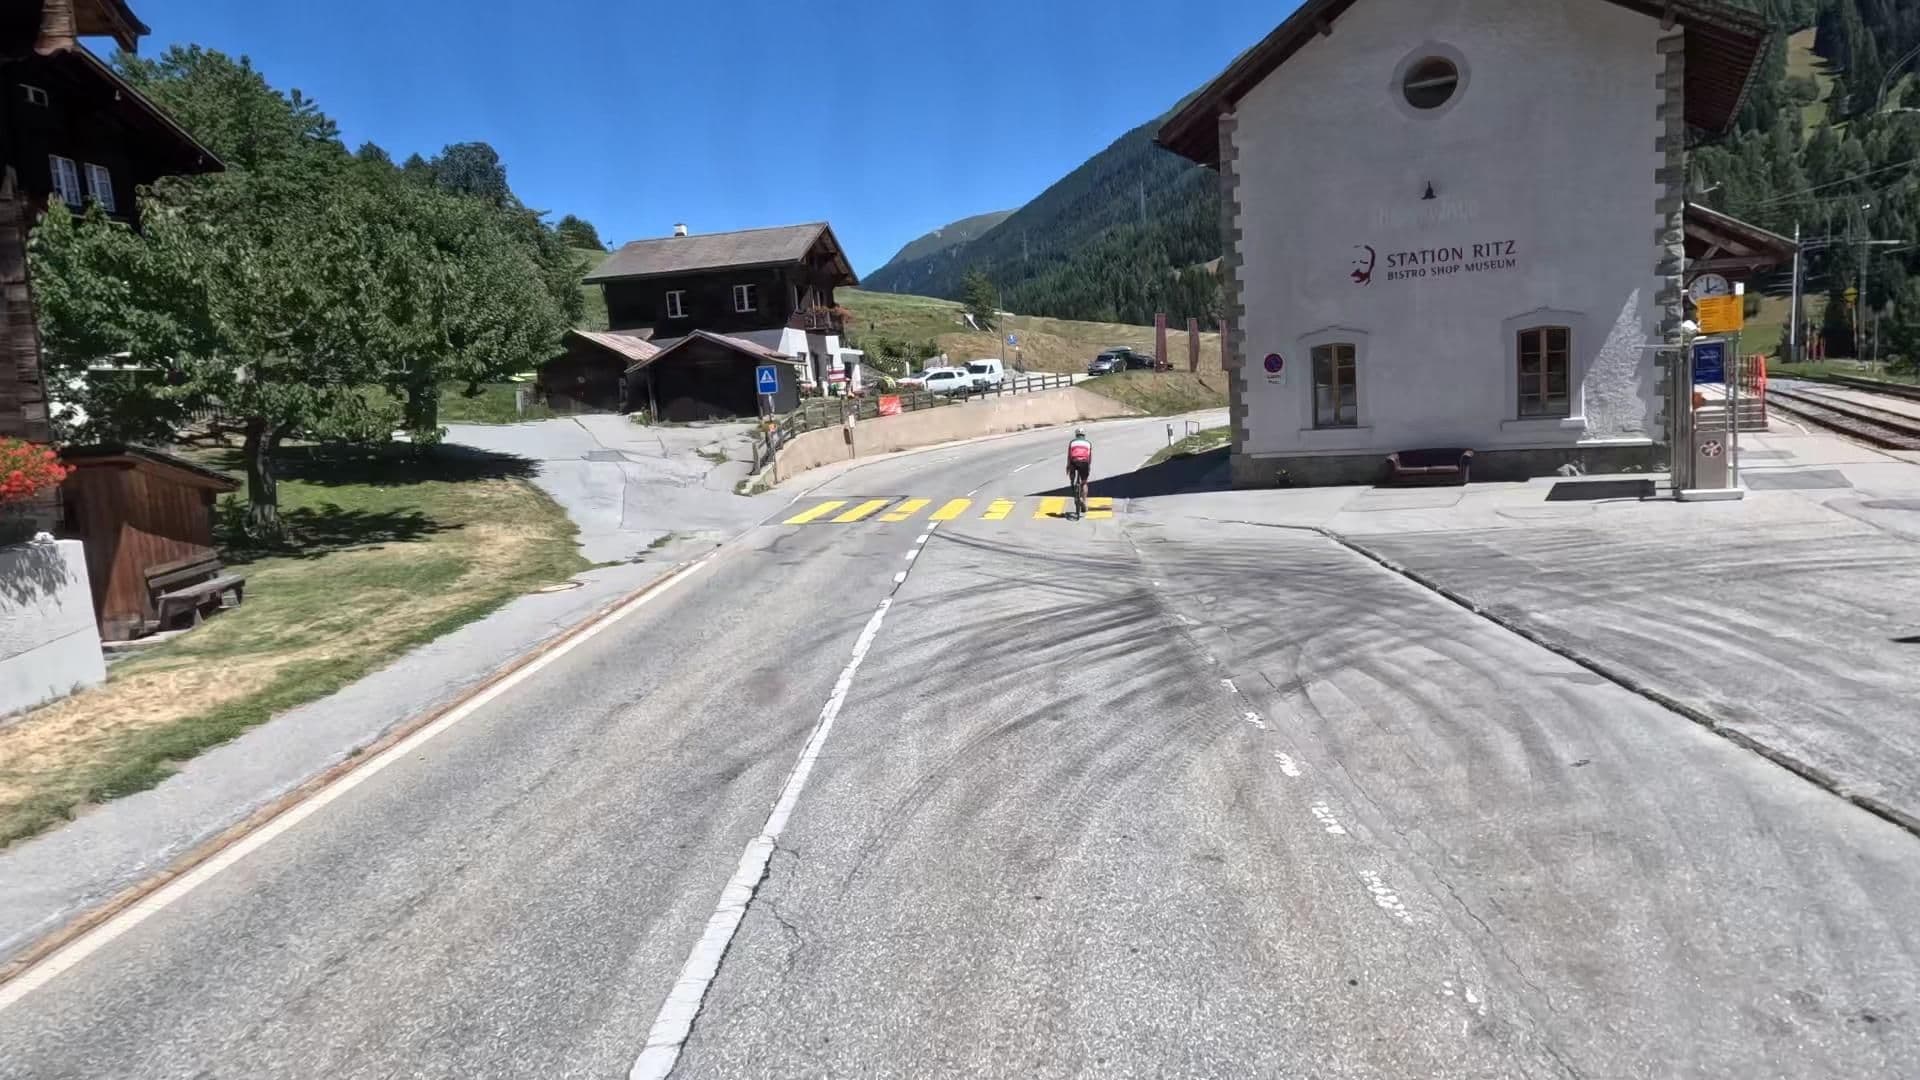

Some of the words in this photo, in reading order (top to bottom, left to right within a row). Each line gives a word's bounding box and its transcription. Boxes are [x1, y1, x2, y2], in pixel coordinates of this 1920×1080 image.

[1387, 247, 1463, 268] STATION
[1472, 240, 1516, 258] RITZ
[1387, 268, 1426, 280] BISTRO
[1430, 264, 1460, 276] SHOP
[1465, 259, 1516, 272] MUSEUM
